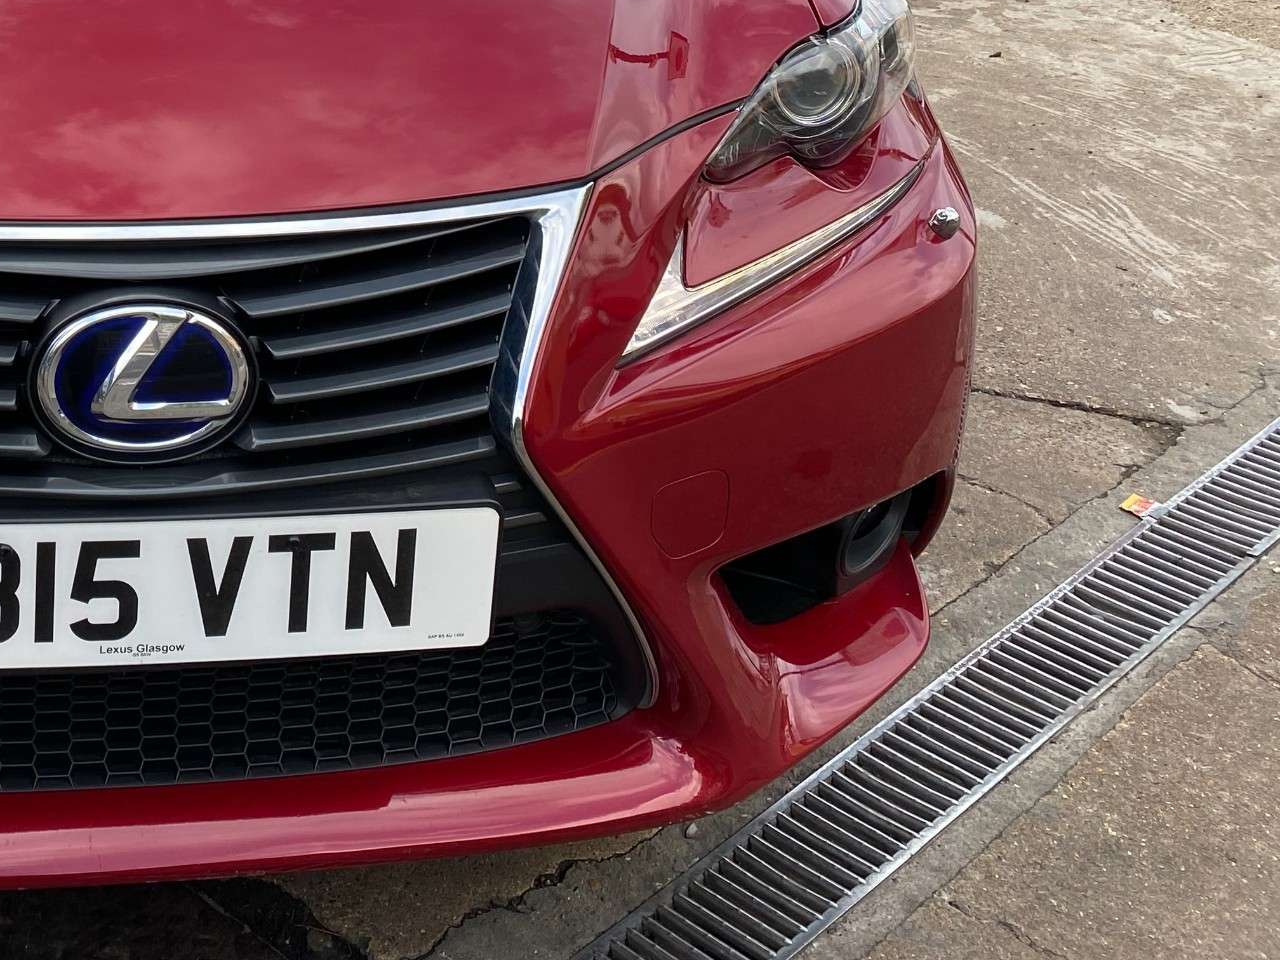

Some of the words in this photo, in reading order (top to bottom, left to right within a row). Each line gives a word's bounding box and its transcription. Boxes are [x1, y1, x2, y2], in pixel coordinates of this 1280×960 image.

[186, 527, 418, 637] VTN
[99, 644, 133, 654] Lexus
[136, 643, 185, 655] Glasgow
